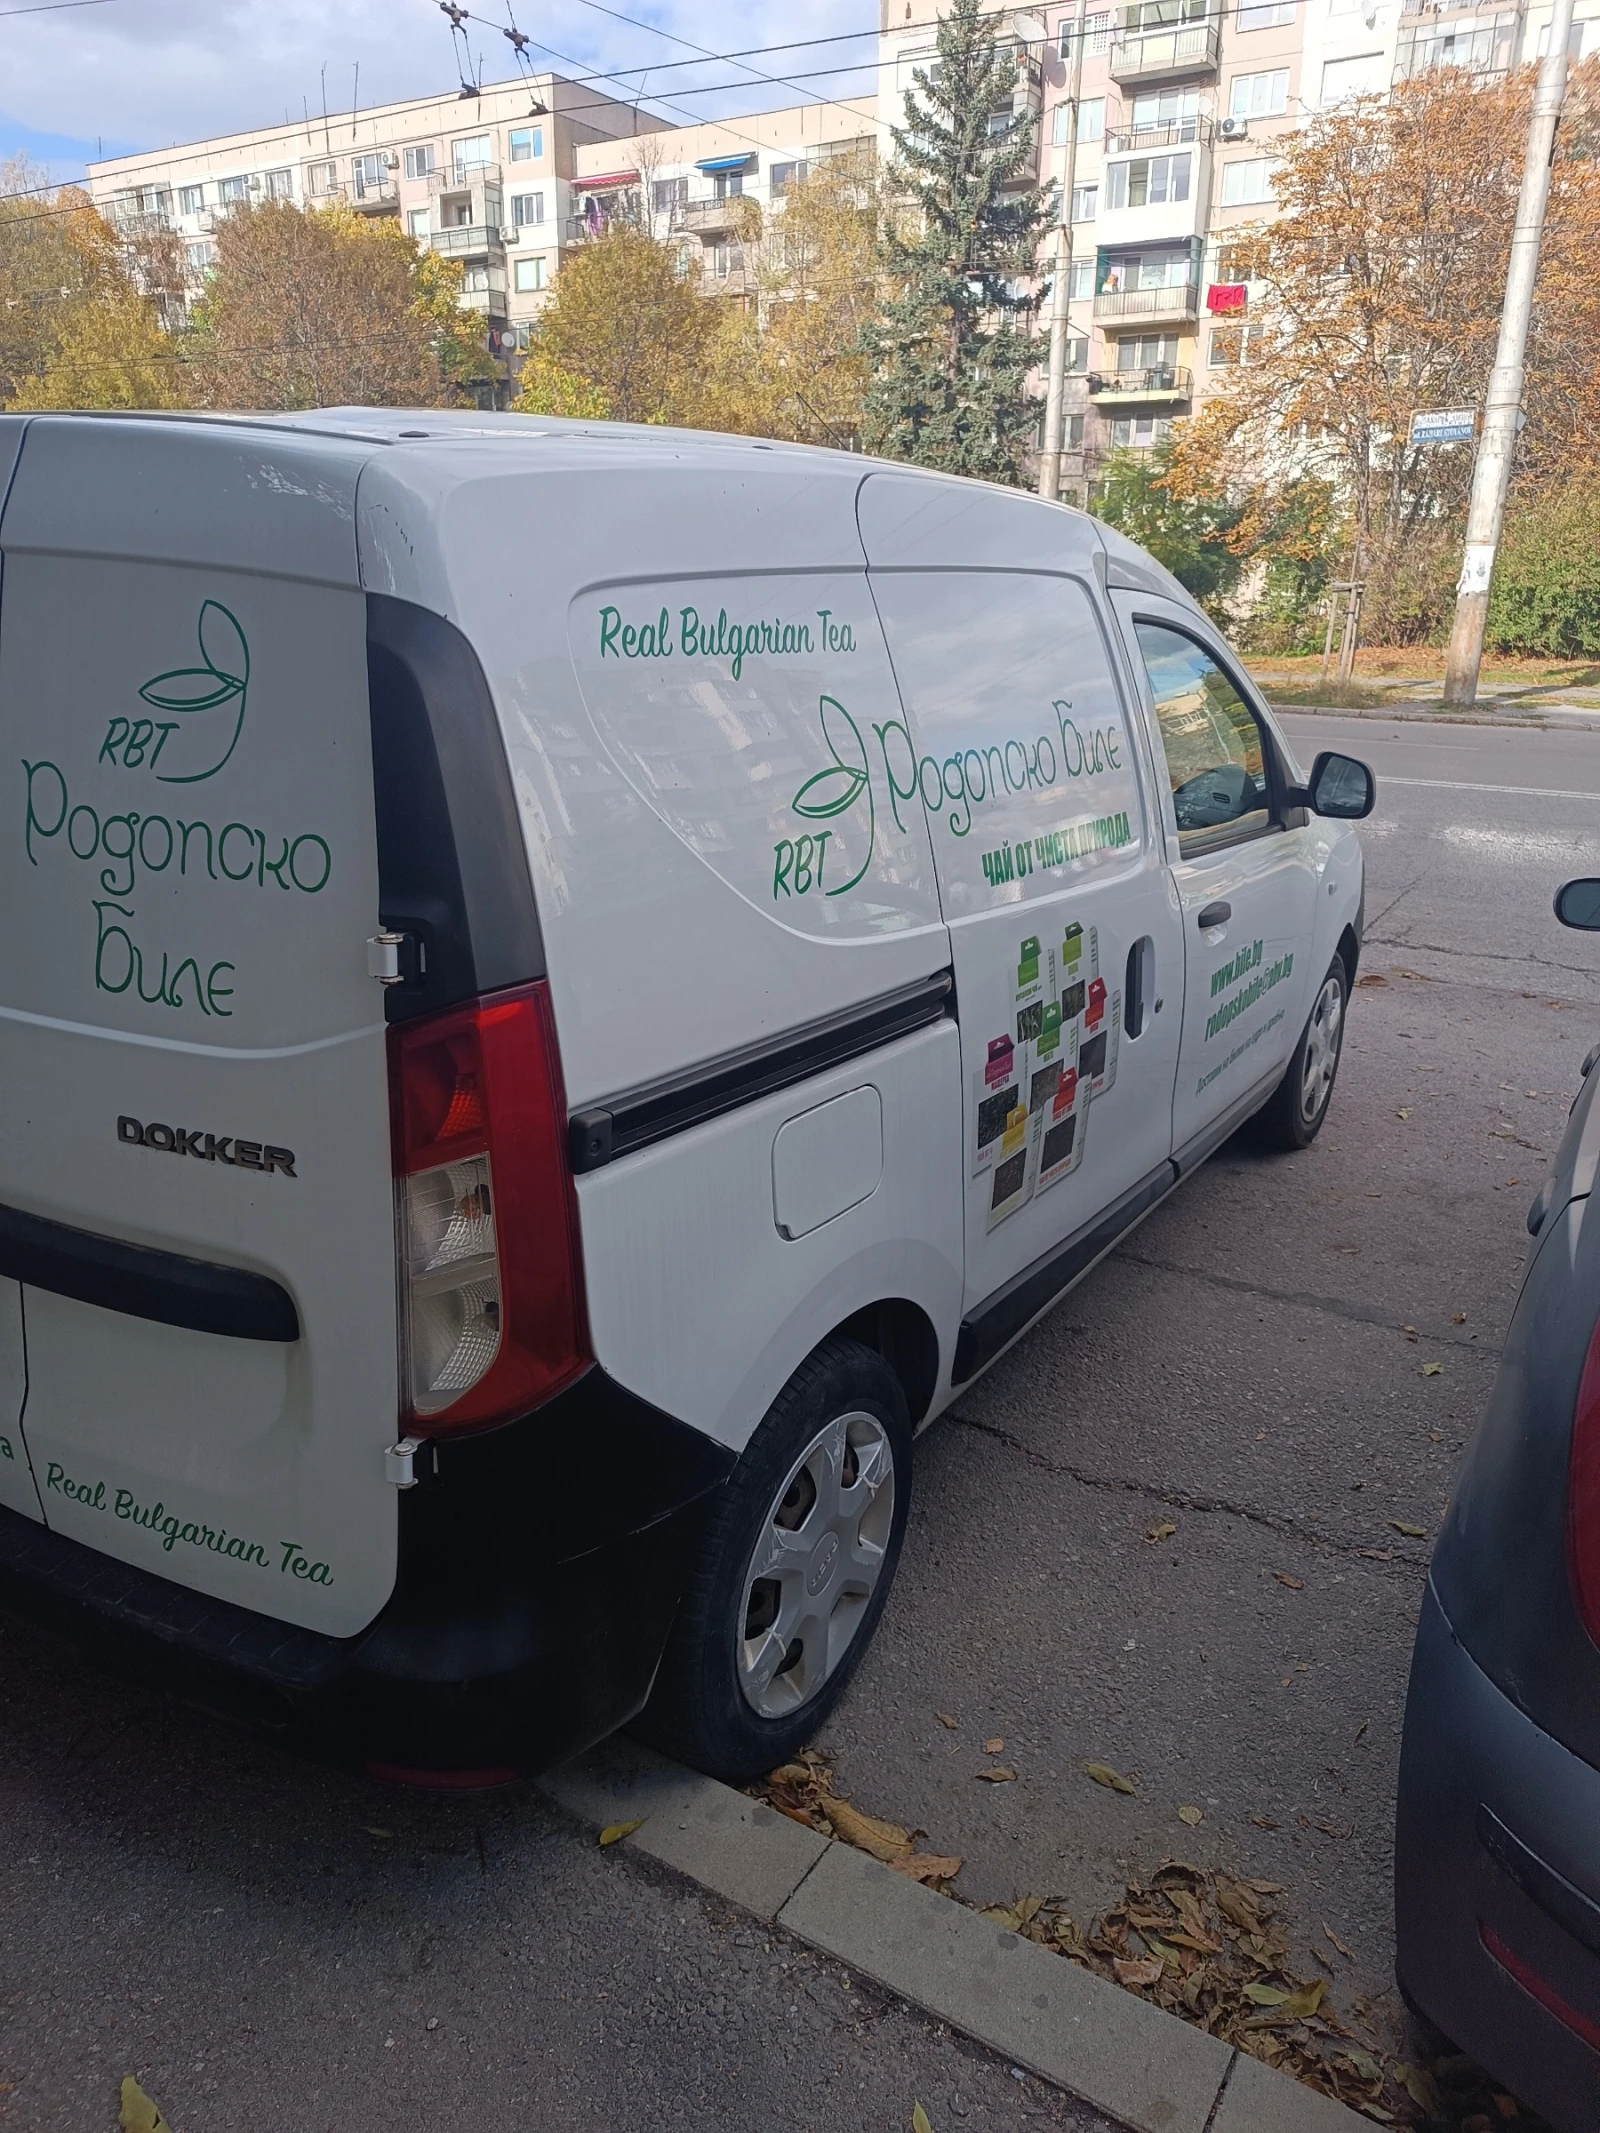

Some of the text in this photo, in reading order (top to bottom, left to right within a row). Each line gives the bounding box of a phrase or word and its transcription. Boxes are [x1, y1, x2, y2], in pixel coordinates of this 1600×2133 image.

[598, 605, 857, 681] Real Bulgarian Tea
[100, 717, 180, 769] RBT
[871, 699, 1122, 837] Родопско Биле
[22, 758, 332, 896] Родопско
[981, 811, 1132, 888] ЧАЙ ОТ ЧИСТА ПРИРОДА
[772, 830, 833, 901] RBT
[92, 900, 236, 1017] Биле
[1210, 939, 1264, 998] www.bile.bg
[117, 1115, 298, 1178] DOKKER
[47, 1462, 335, 1587] Real Bulgarian Tea
